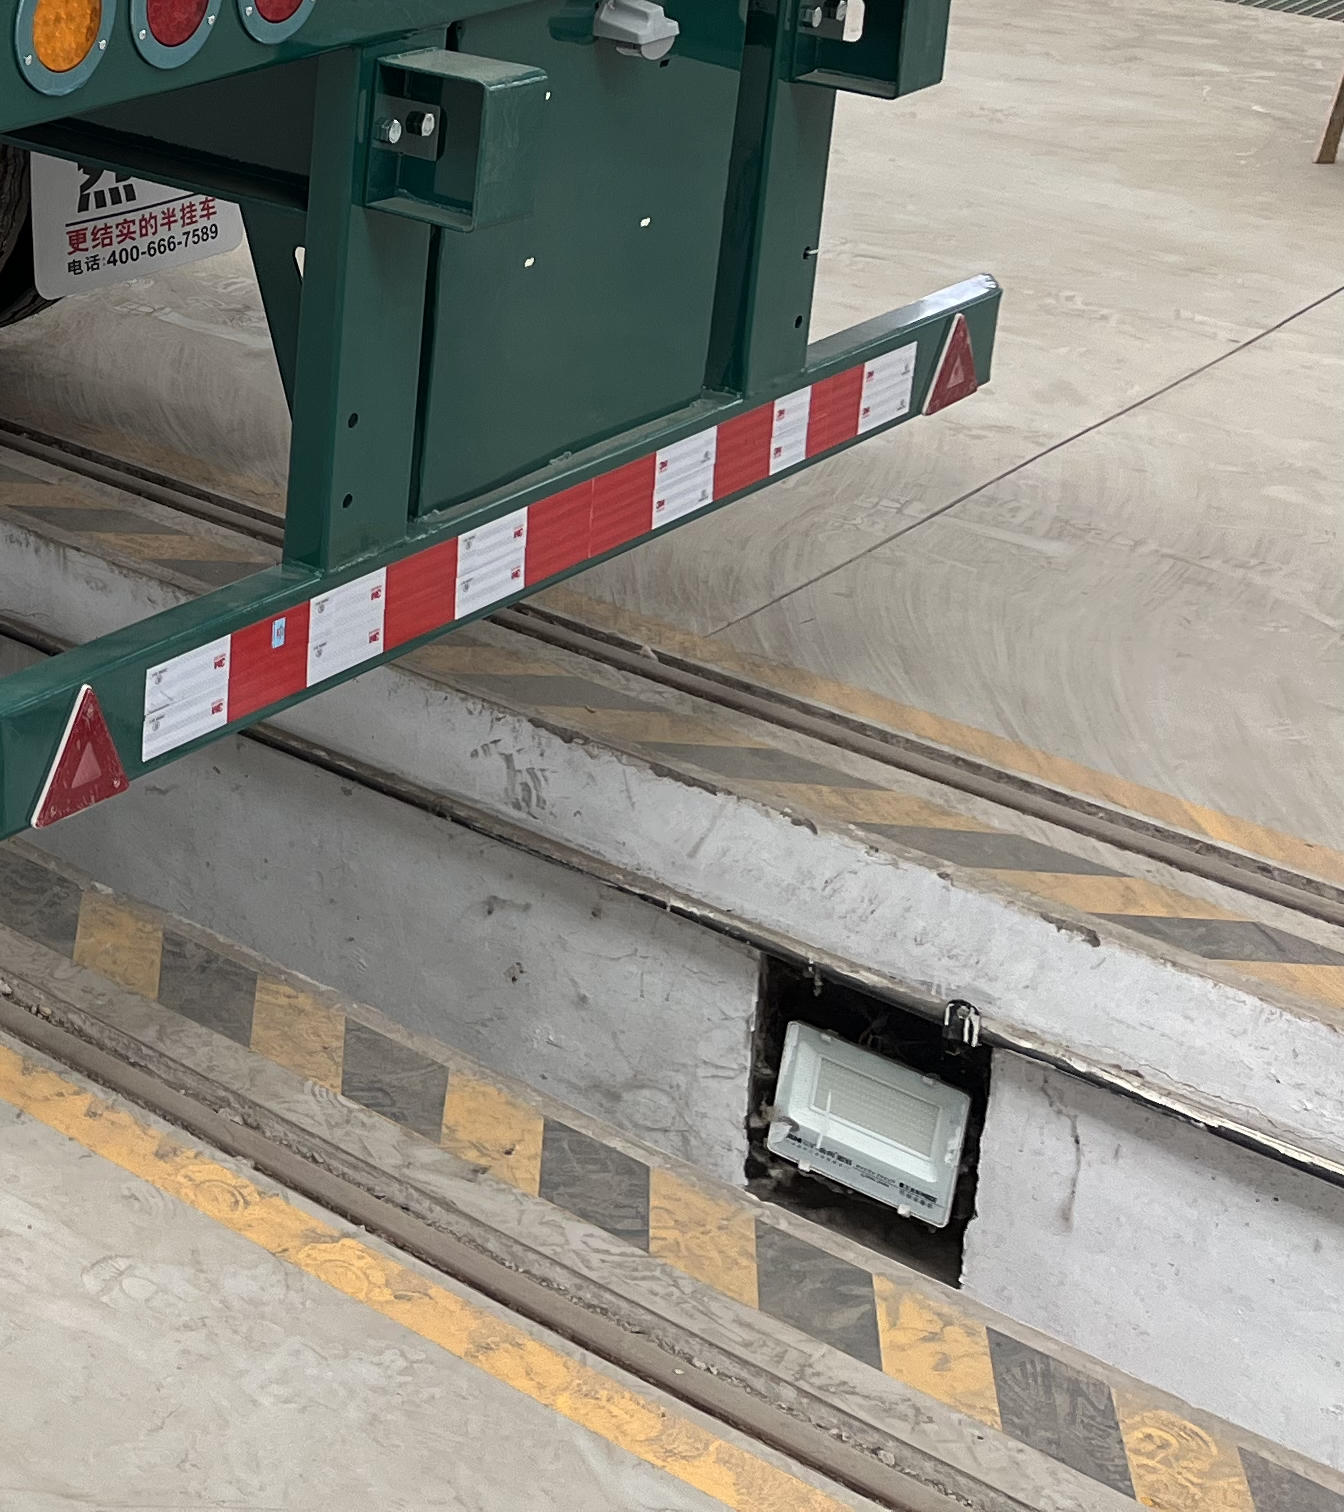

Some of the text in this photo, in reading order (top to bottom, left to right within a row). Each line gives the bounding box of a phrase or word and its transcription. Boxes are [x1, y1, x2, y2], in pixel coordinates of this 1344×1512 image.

[65, 196, 218, 256] 更结实的半挂车
